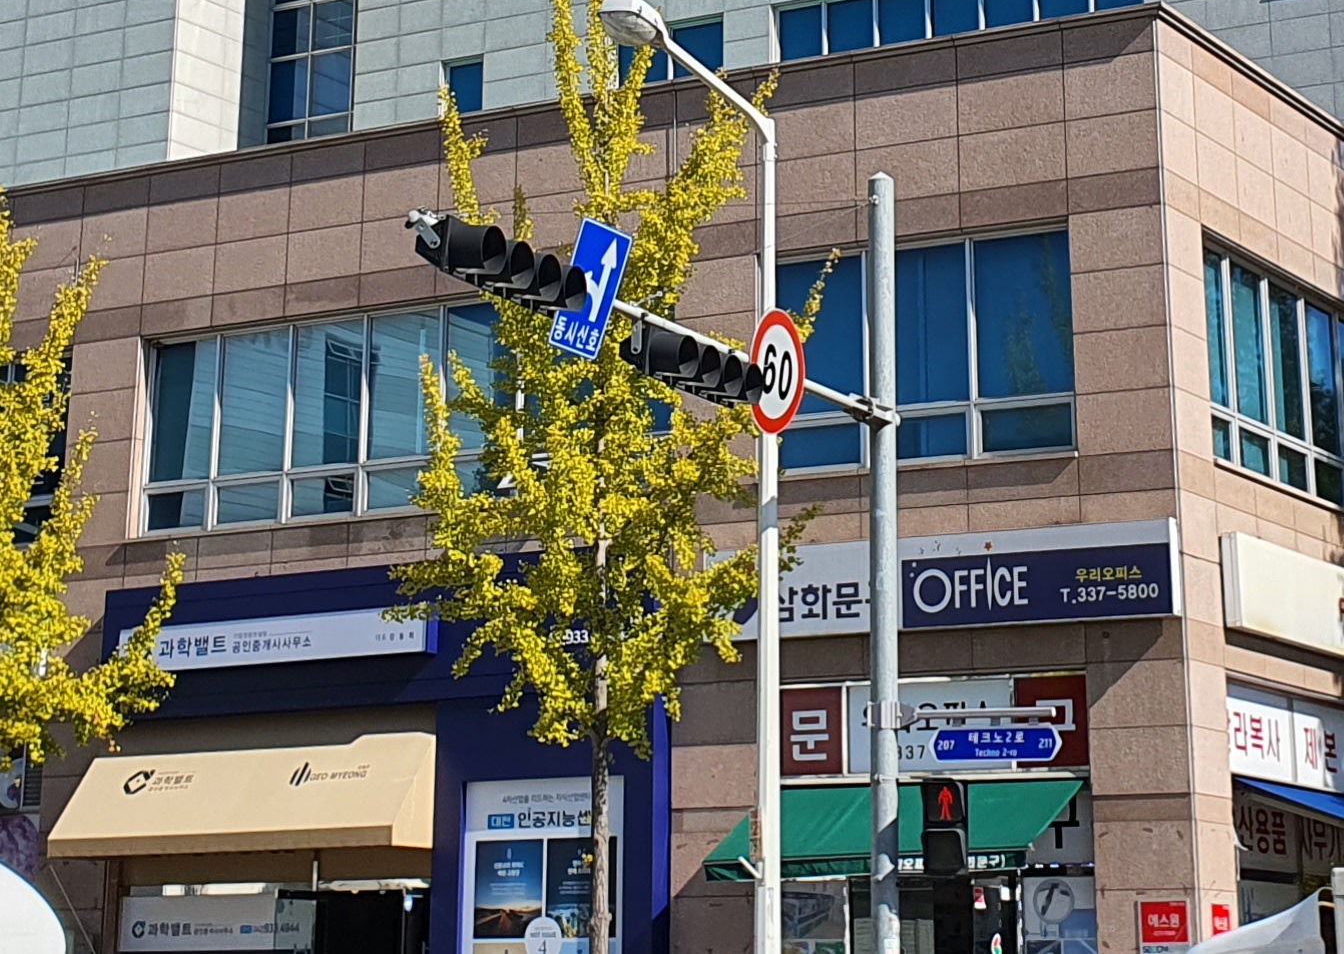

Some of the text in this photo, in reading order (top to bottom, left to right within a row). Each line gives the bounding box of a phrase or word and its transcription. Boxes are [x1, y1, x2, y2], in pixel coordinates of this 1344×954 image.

[553, 315, 600, 352] 동시신호
[762, 344, 793, 400] 60
[1075, 565, 1143, 584] 우리오피스
[912, 557, 1029, 614] OFFICE
[1059, 582, 1160, 606] T.337-5800
[778, 580, 871, 623] 삼화문
[789, 709, 828, 761] 문
[937, 739, 955, 751] 207
[968, 730, 1025, 744] 테크노2로
[1037, 737, 1053, 749] 211
[1226, 711, 1280, 763] 라복사
[975, 748, 1000, 757] Techno
[518, 809, 592, 828] 인공지능센
[1147, 913, 1180, 928] 에스원
